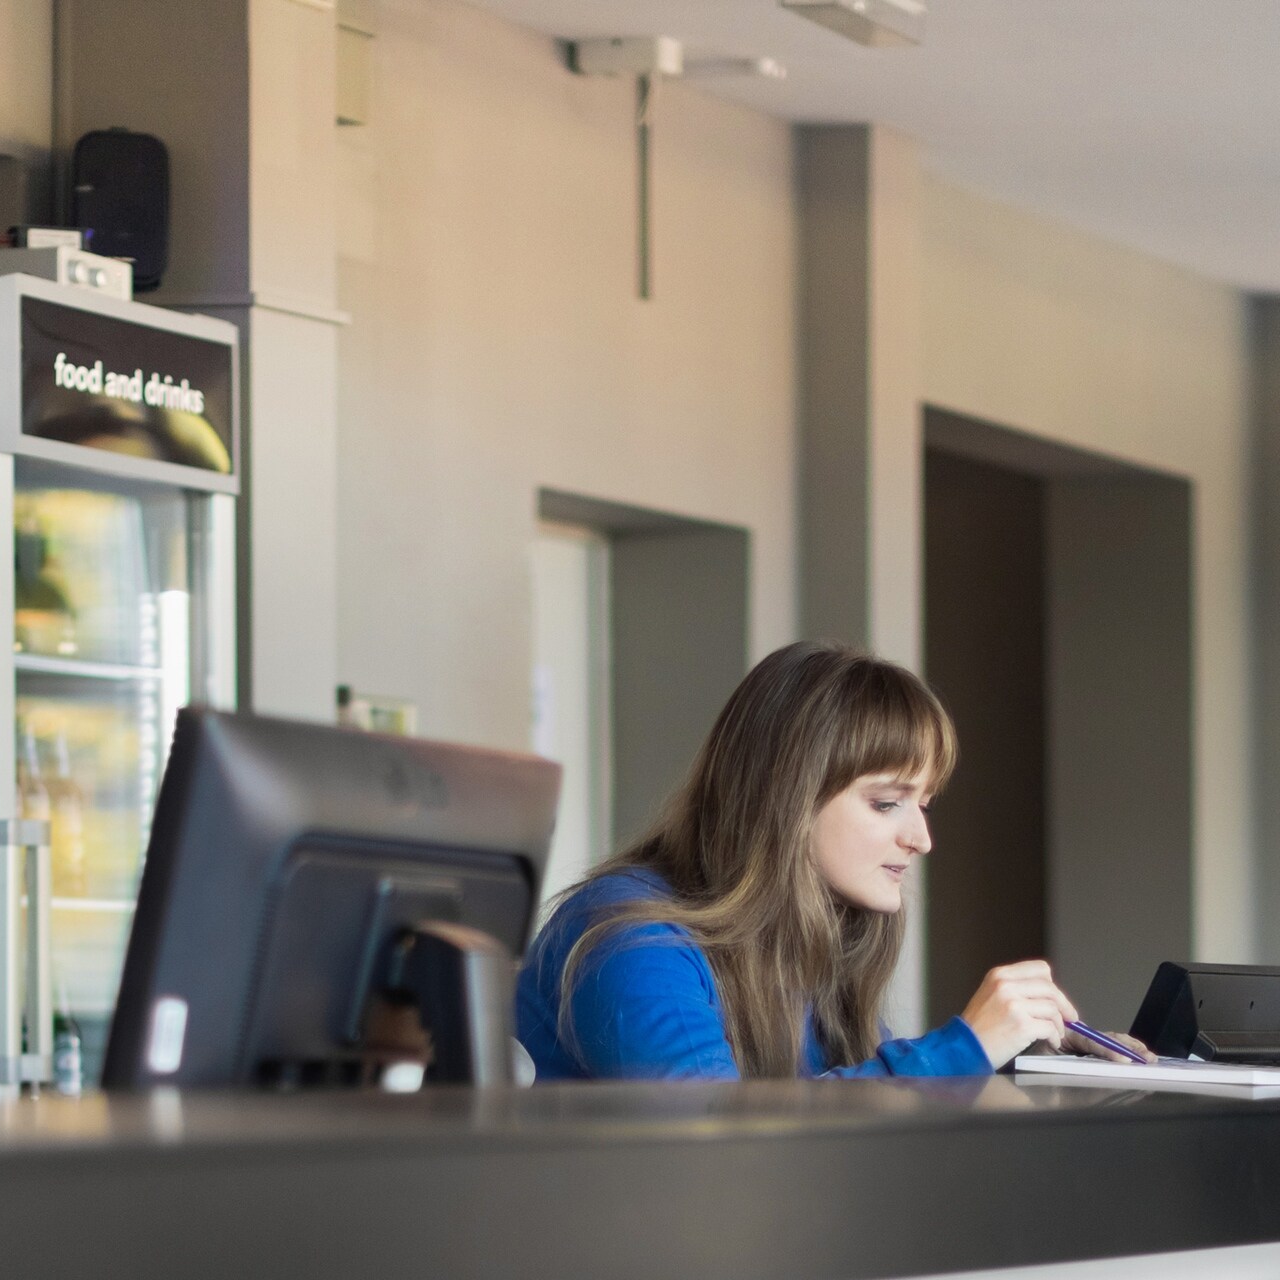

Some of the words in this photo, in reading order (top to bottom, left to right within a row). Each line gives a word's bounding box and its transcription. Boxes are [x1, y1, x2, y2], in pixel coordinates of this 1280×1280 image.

[54, 352, 103, 394] food
[104, 368, 144, 403] and
[144, 372, 205, 414] drinks
